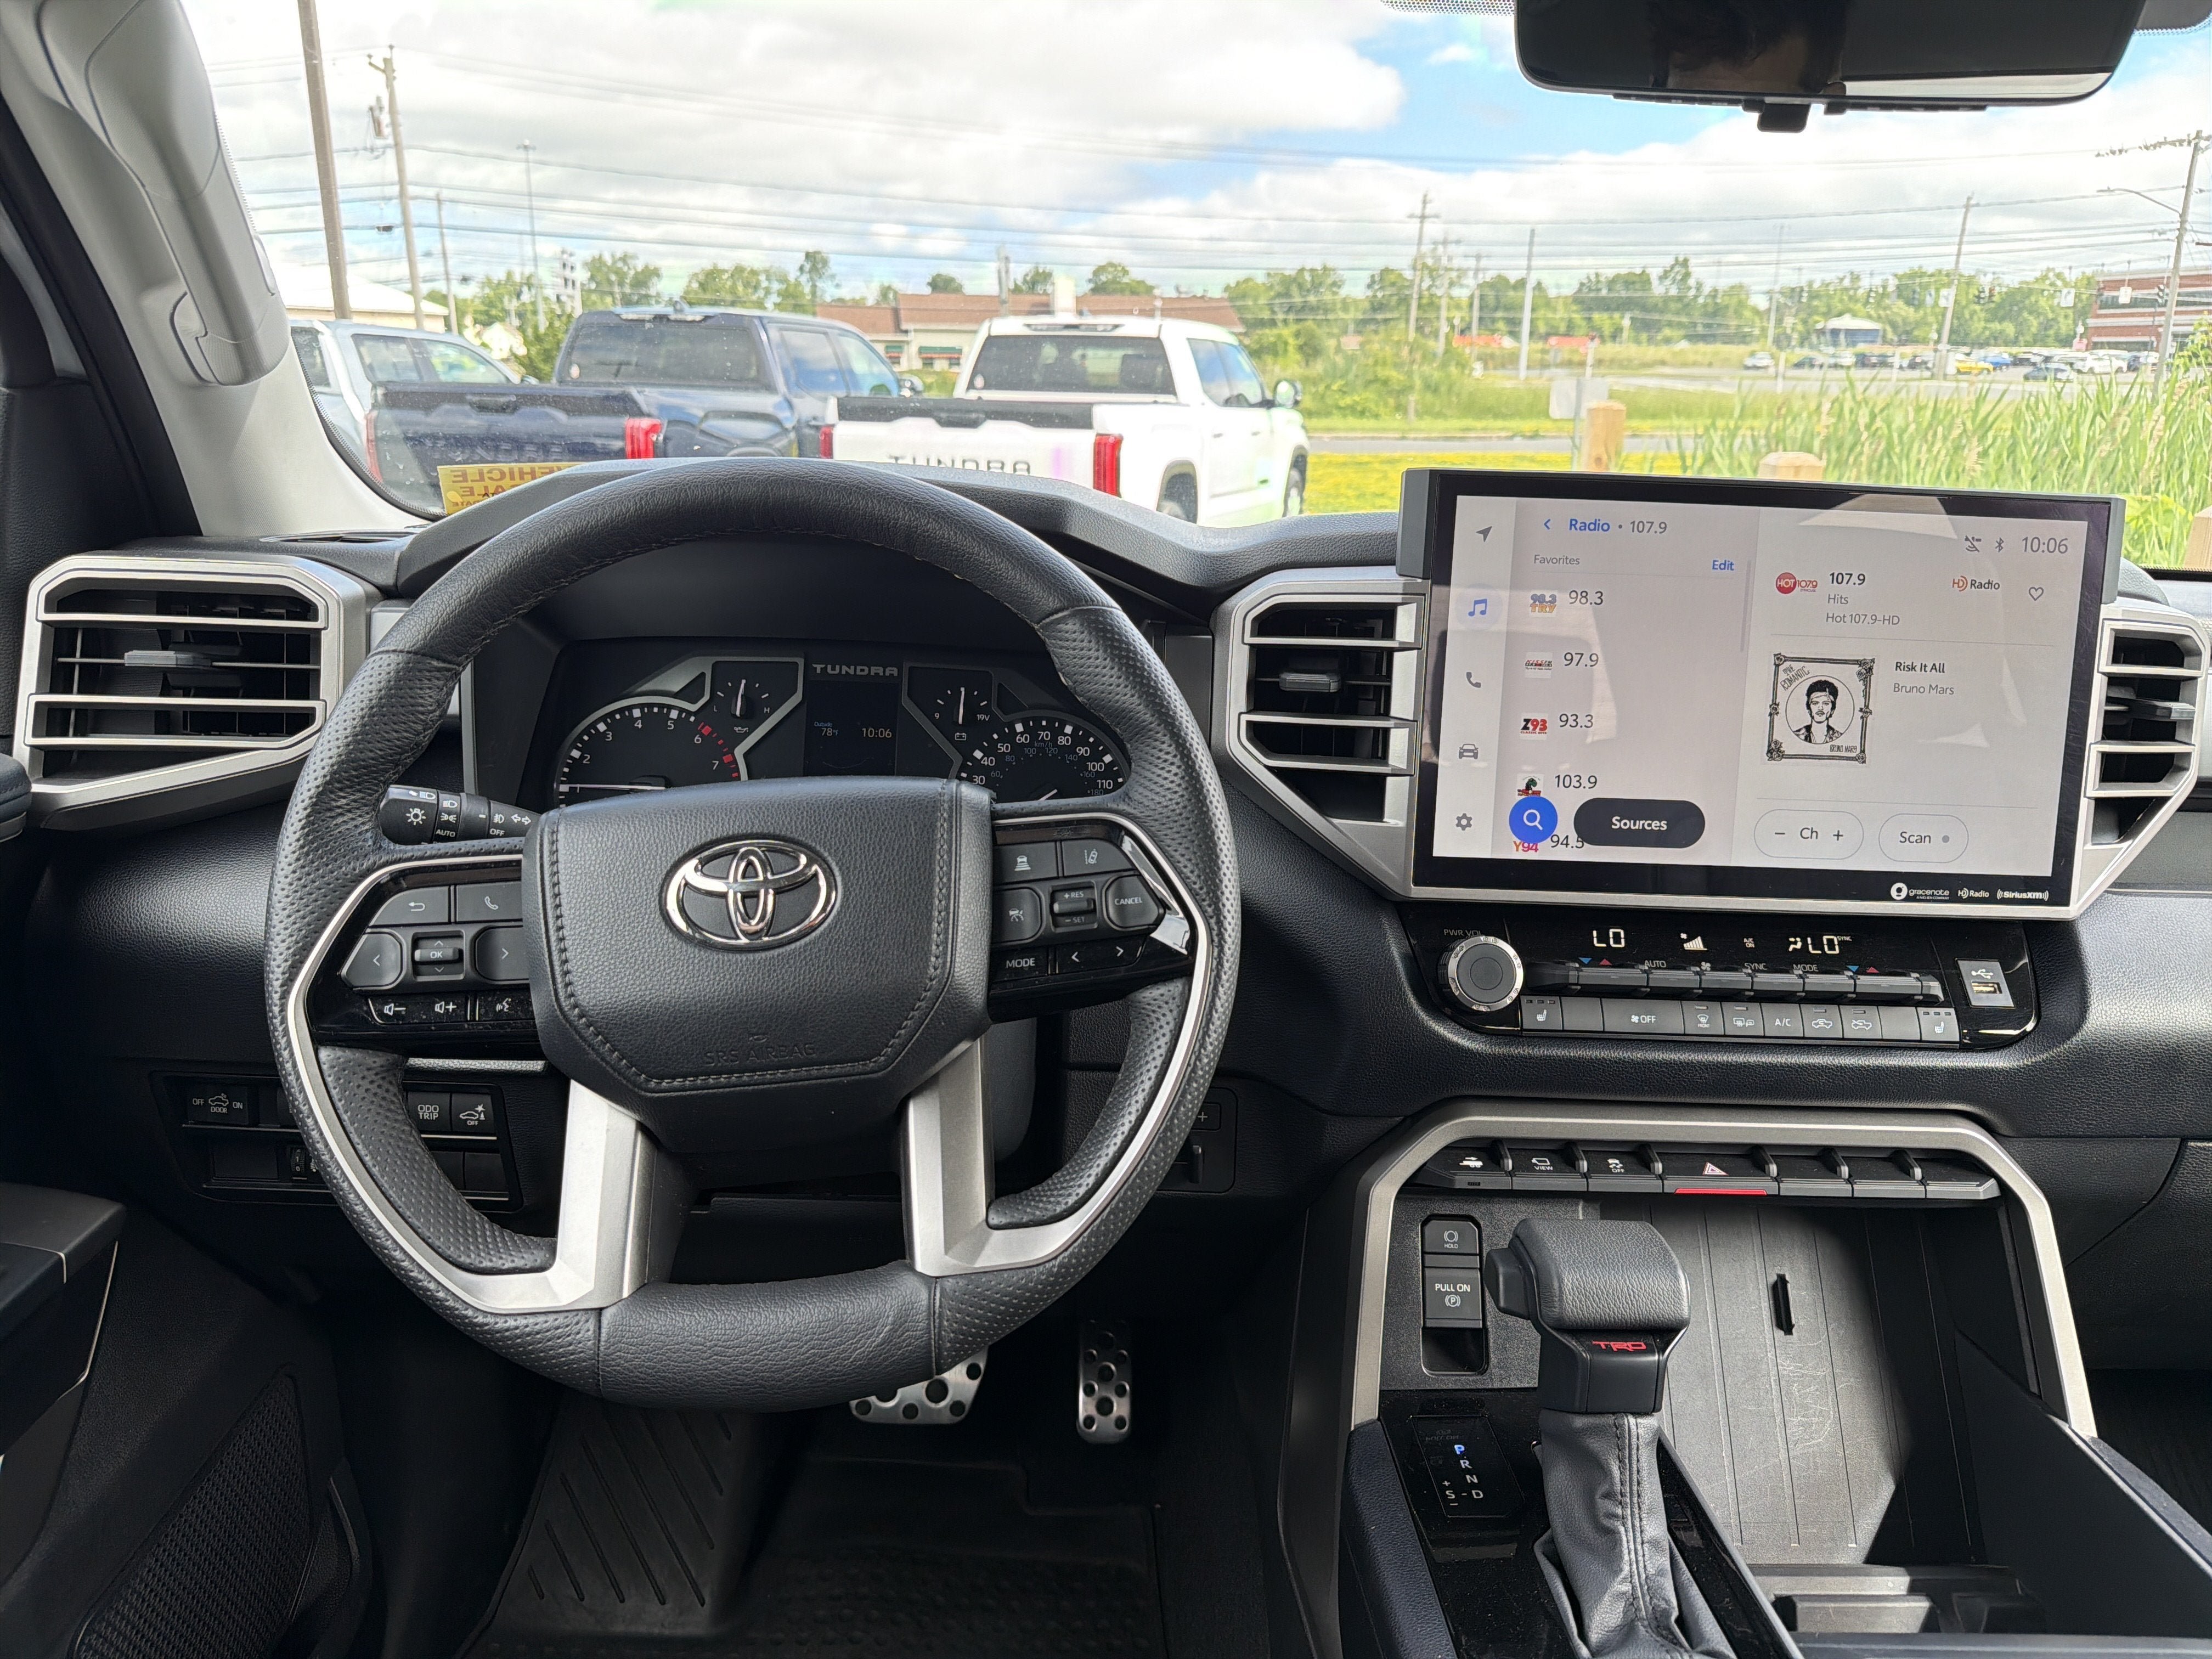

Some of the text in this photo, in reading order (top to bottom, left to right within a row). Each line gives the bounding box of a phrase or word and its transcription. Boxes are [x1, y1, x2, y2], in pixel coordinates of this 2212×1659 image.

[1569, 518, 1667, 534] Radio 107.9
[2022, 537, 2068, 554] 10:06
[1534, 554, 1580, 566] Favorites
[1712, 560, 1734, 571] Edit
[1777, 579, 1795, 588] HOT
[1830, 572, 1865, 585] 107.9
[1970, 579, 2000, 590] Radio
[1531, 594, 1557, 604] 98.3
[1568, 590, 1604, 606] 98.3
[1827, 594, 1848, 605] Hits
[1530, 603, 1556, 613] TRY
[1826, 613, 1900, 625] Hot 107.9-HD
[1564, 652, 1599, 667] 97.9
[812, 664, 898, 676] TUNDRA
[1895, 662, 1945, 673] Risk It All
[1893, 684, 1954, 695] Bruno Mars
[634, 720, 642, 729] 4
[667, 720, 674, 730] 5
[1521, 719, 1547, 731] Z93
[1559, 714, 1594, 729] 93.3
[605, 732, 612, 741] 3
[862, 728, 892, 738] 10:06
[1037, 731, 1050, 742] 70
[695, 735, 701, 744] 6
[1016, 733, 1030, 744] 60
[1058, 736, 1071, 746] 80
[997, 743, 1011, 753] 50
[1034, 740, 1053, 748] km/h
[1076, 747, 1090, 757] 90
[583, 754, 590, 764] 2
[981, 757, 995, 767] 40
[712, 761, 719, 770] 7
[1086, 762, 1104, 772] 100
[972, 775, 986, 786] 30
[1097, 780, 1113, 789] 110
[1555, 775, 1597, 790] 103.9
[1612, 816, 1667, 831] Sources
[436, 829, 456, 838] AUTO
[490, 828, 505, 837] OFF
[1800, 827, 1818, 840] Ch
[1900, 831, 1931, 844] Scan
[1550, 834, 1585, 849] 94.5
[1909, 888, 1949, 896] gracenote
[1114, 897, 1142, 905] CANCEL
[1593, 928, 1625, 948] LO
[1808, 935, 1839, 954] LO
[1006, 958, 1035, 968] MODE
[1644, 960, 1667, 969] AUTO
[1793, 964, 1818, 972] MODE
[1640, 1015, 1656, 1024] OFF
[1775, 1018, 1791, 1027] A/C
[703, 1044, 817, 1066] SRS AIRBAG
[417, 1104, 438, 1113] ODO
[419, 1111, 438, 1120] TRIP
[1435, 1283, 1470, 1292] PULL ON
[1592, 1341, 1646, 1352] TRD
[1454, 1444, 1465, 1454] P
[1460, 1459, 1472, 1469] R
[1466, 1475, 1478, 1483] N
[1446, 1490, 1483, 1499] S D
